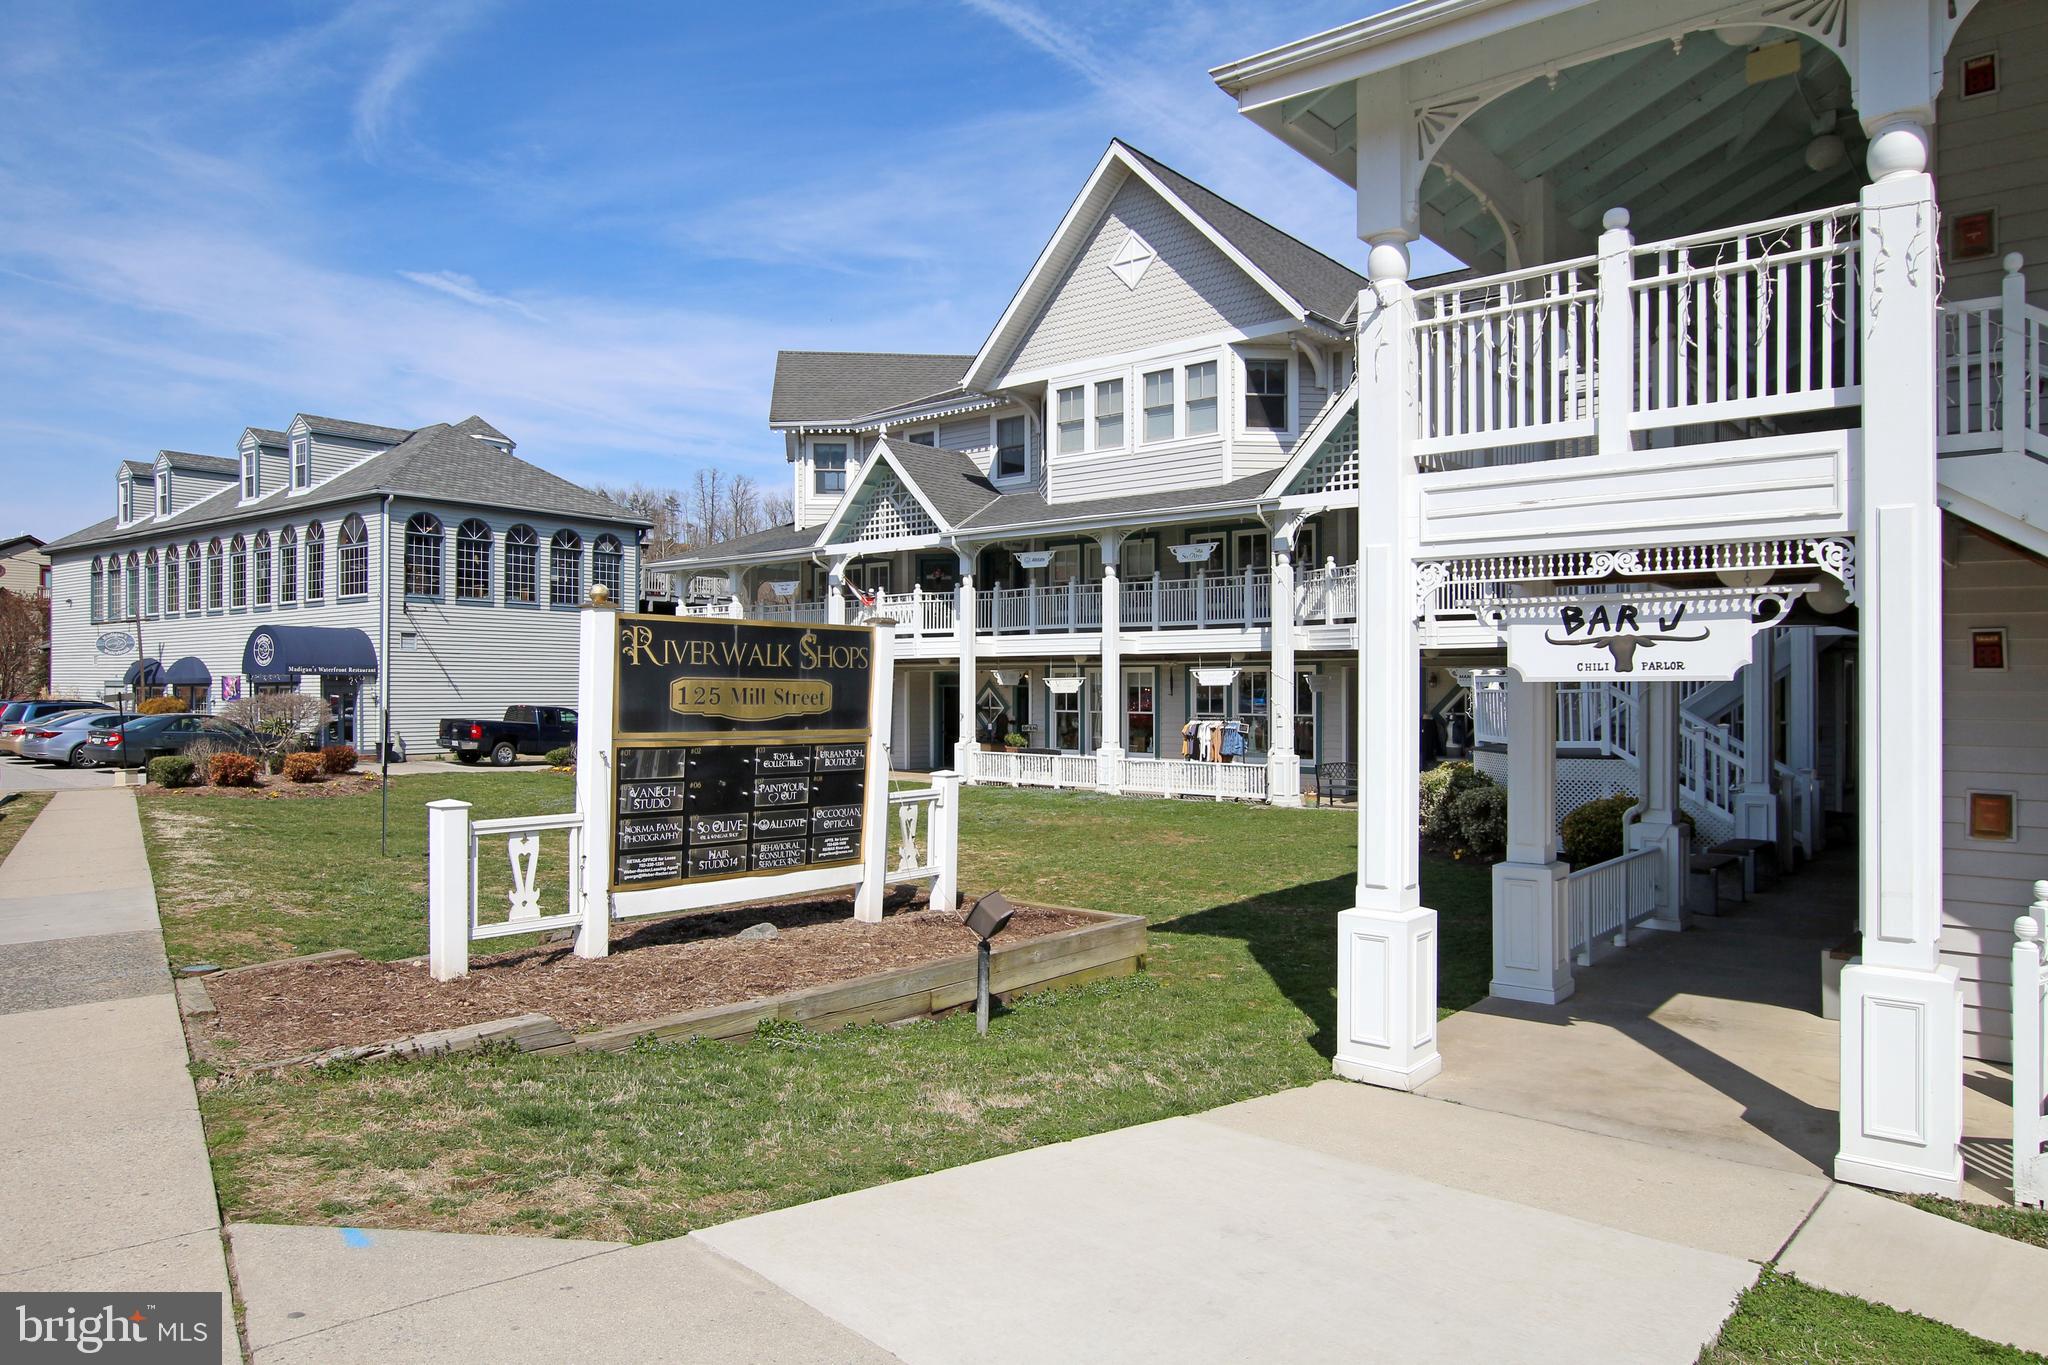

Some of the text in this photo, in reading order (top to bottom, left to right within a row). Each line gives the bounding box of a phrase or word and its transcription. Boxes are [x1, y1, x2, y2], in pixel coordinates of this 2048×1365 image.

[1561, 603, 1686, 636] BAR J
[799, 633, 869, 670] SHOPS
[288, 665, 317, 673] Madigan's
[1577, 661, 1685, 672] CHILI PARLOR
[678, 686, 825, 706] 125 Mill Street
[773, 752, 794, 761] TOYS &
[763, 759, 804, 768] COLLECTIBLES
[824, 758, 857, 767] BOUTIQUE
[759, 784, 781, 793] PAINT
[780, 791, 797, 800] OUT
[633, 798, 671, 810] STUDIO
[816, 808, 861, 818] OCCOQUAN
[712, 820, 743, 833] OLIVE
[770, 818, 804, 829] ALLSTATE
[823, 818, 854, 829] OPTICAL
[624, 825, 655, 834] NORMA
[624, 832, 680, 843] PHOTOGRAPHY
[760, 841, 800, 852] BEHAVIORAL
[708, 849, 730, 860] HAIR
[759, 850, 801, 860] CONSULTING
[698, 857, 738, 870] STUDIO 14
